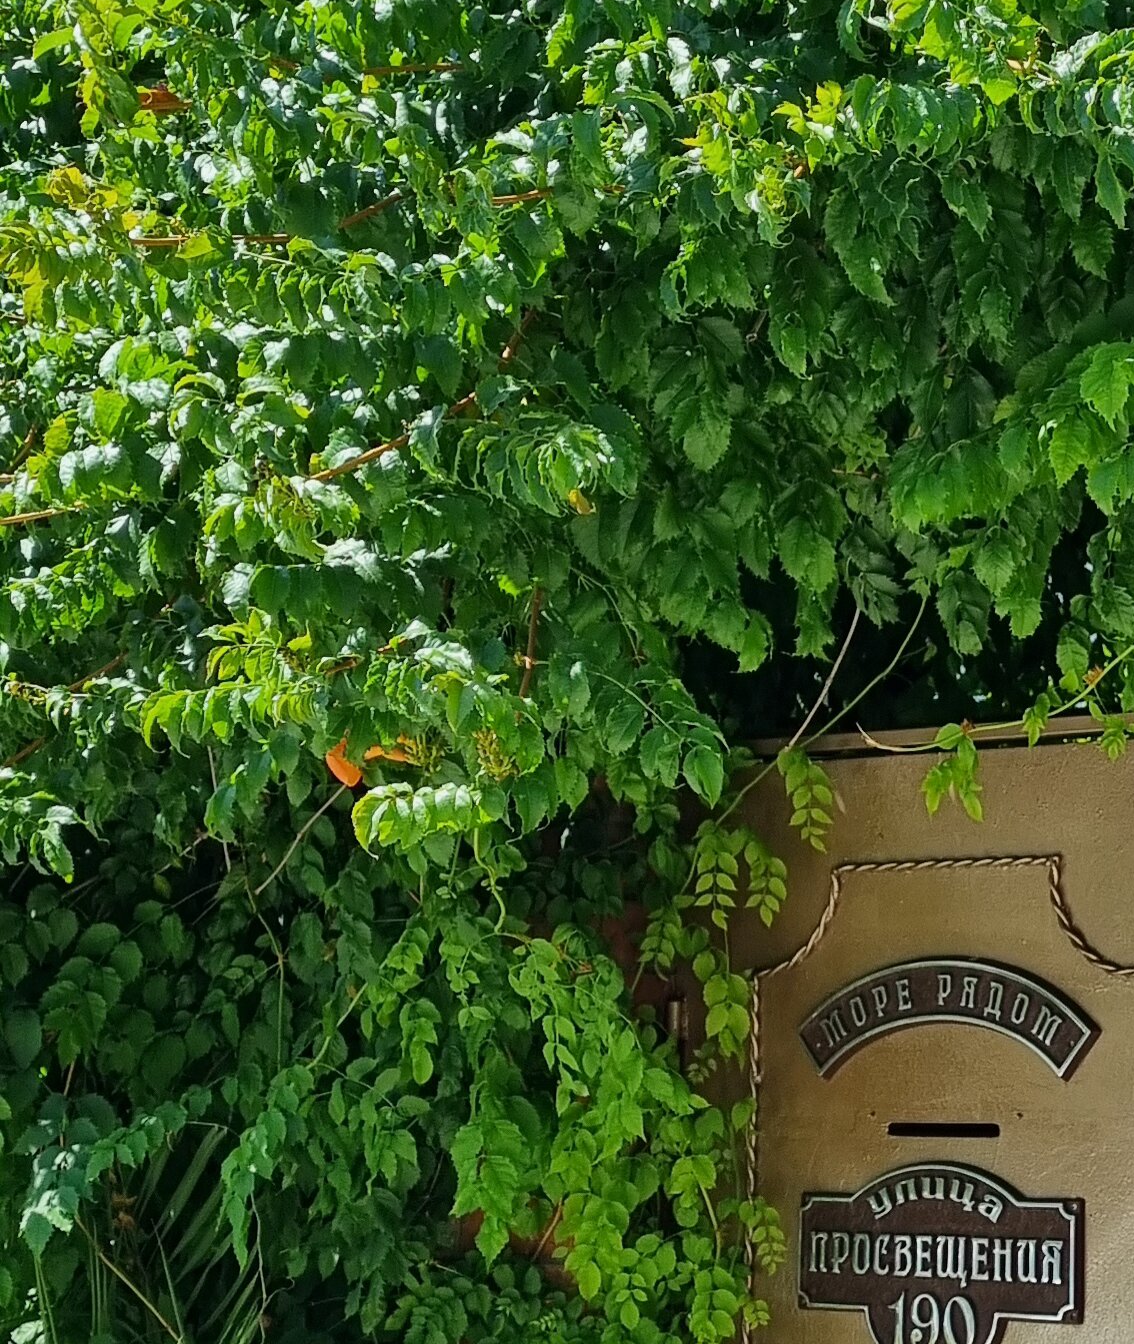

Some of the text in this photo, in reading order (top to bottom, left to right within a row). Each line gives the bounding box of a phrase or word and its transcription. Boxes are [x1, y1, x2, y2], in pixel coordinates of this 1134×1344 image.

[819, 974, 1063, 1048] МОРЕ РЯДОМ
[866, 1176, 1004, 1224] улица
[808, 1230, 1064, 1289] ПРОСВЕЩЕНИЯ
